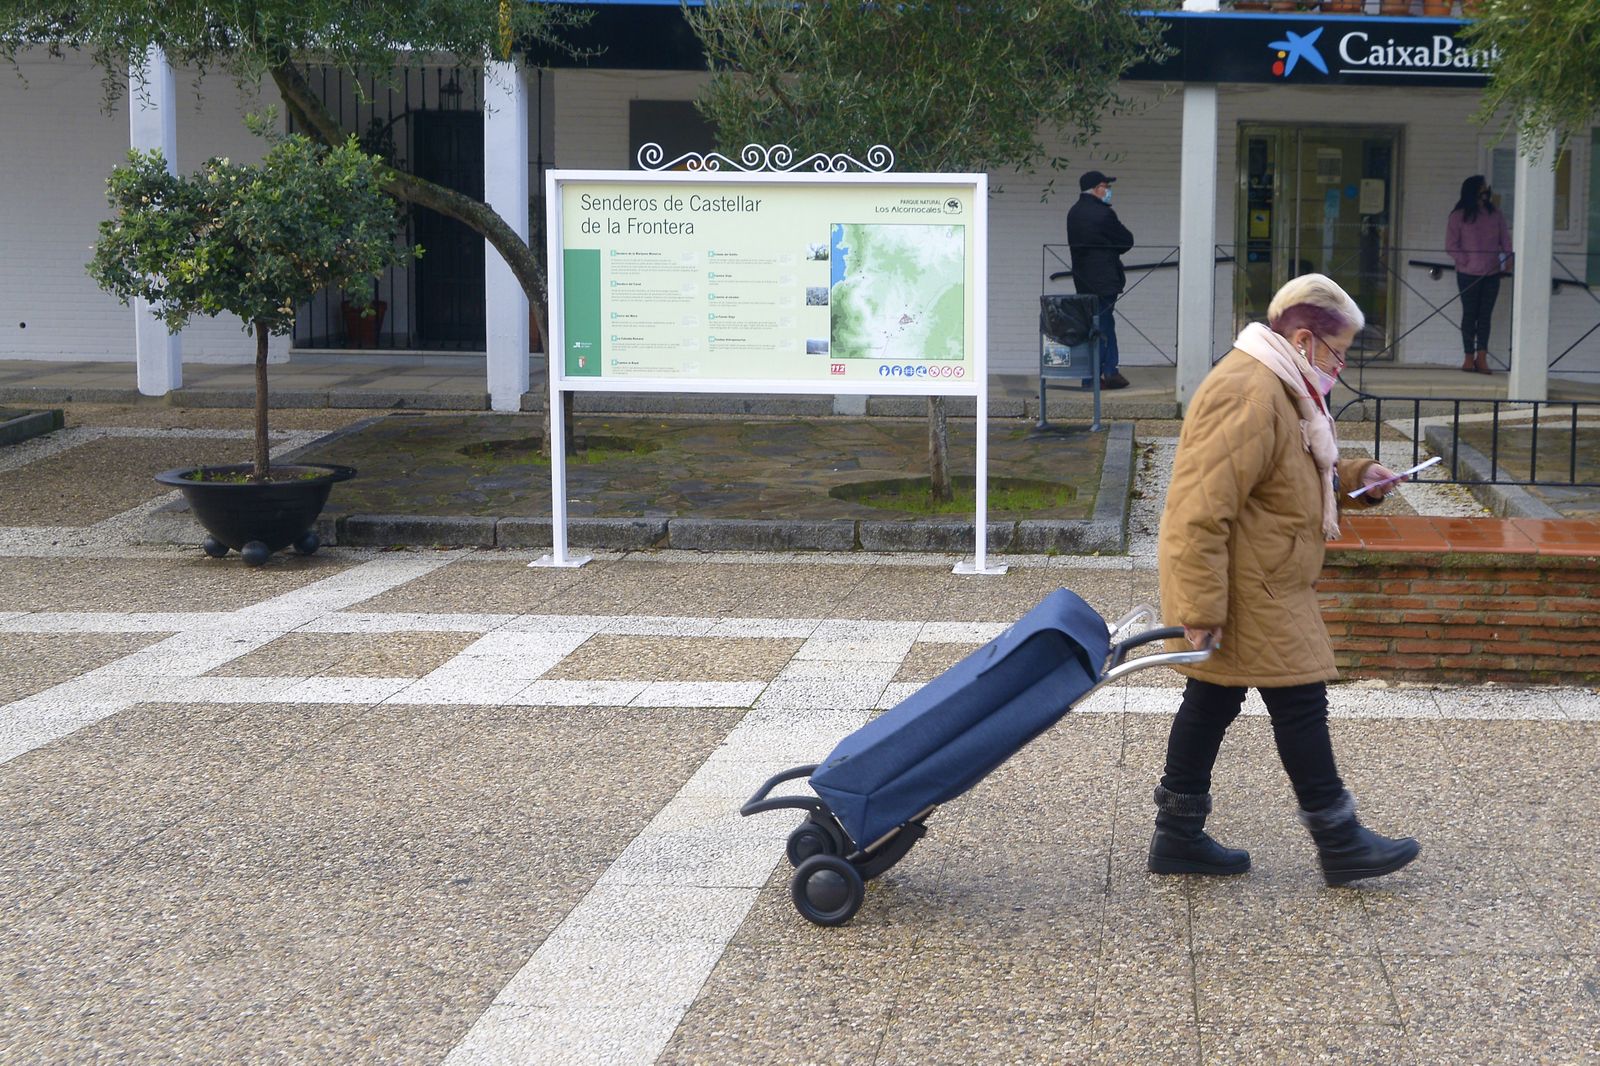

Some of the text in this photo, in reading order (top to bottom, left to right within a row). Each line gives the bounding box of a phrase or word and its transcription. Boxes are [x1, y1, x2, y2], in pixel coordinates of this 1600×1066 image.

[581, 193, 761, 212] Senderos de Castellar
[581, 217, 694, 234] de la Frontera
